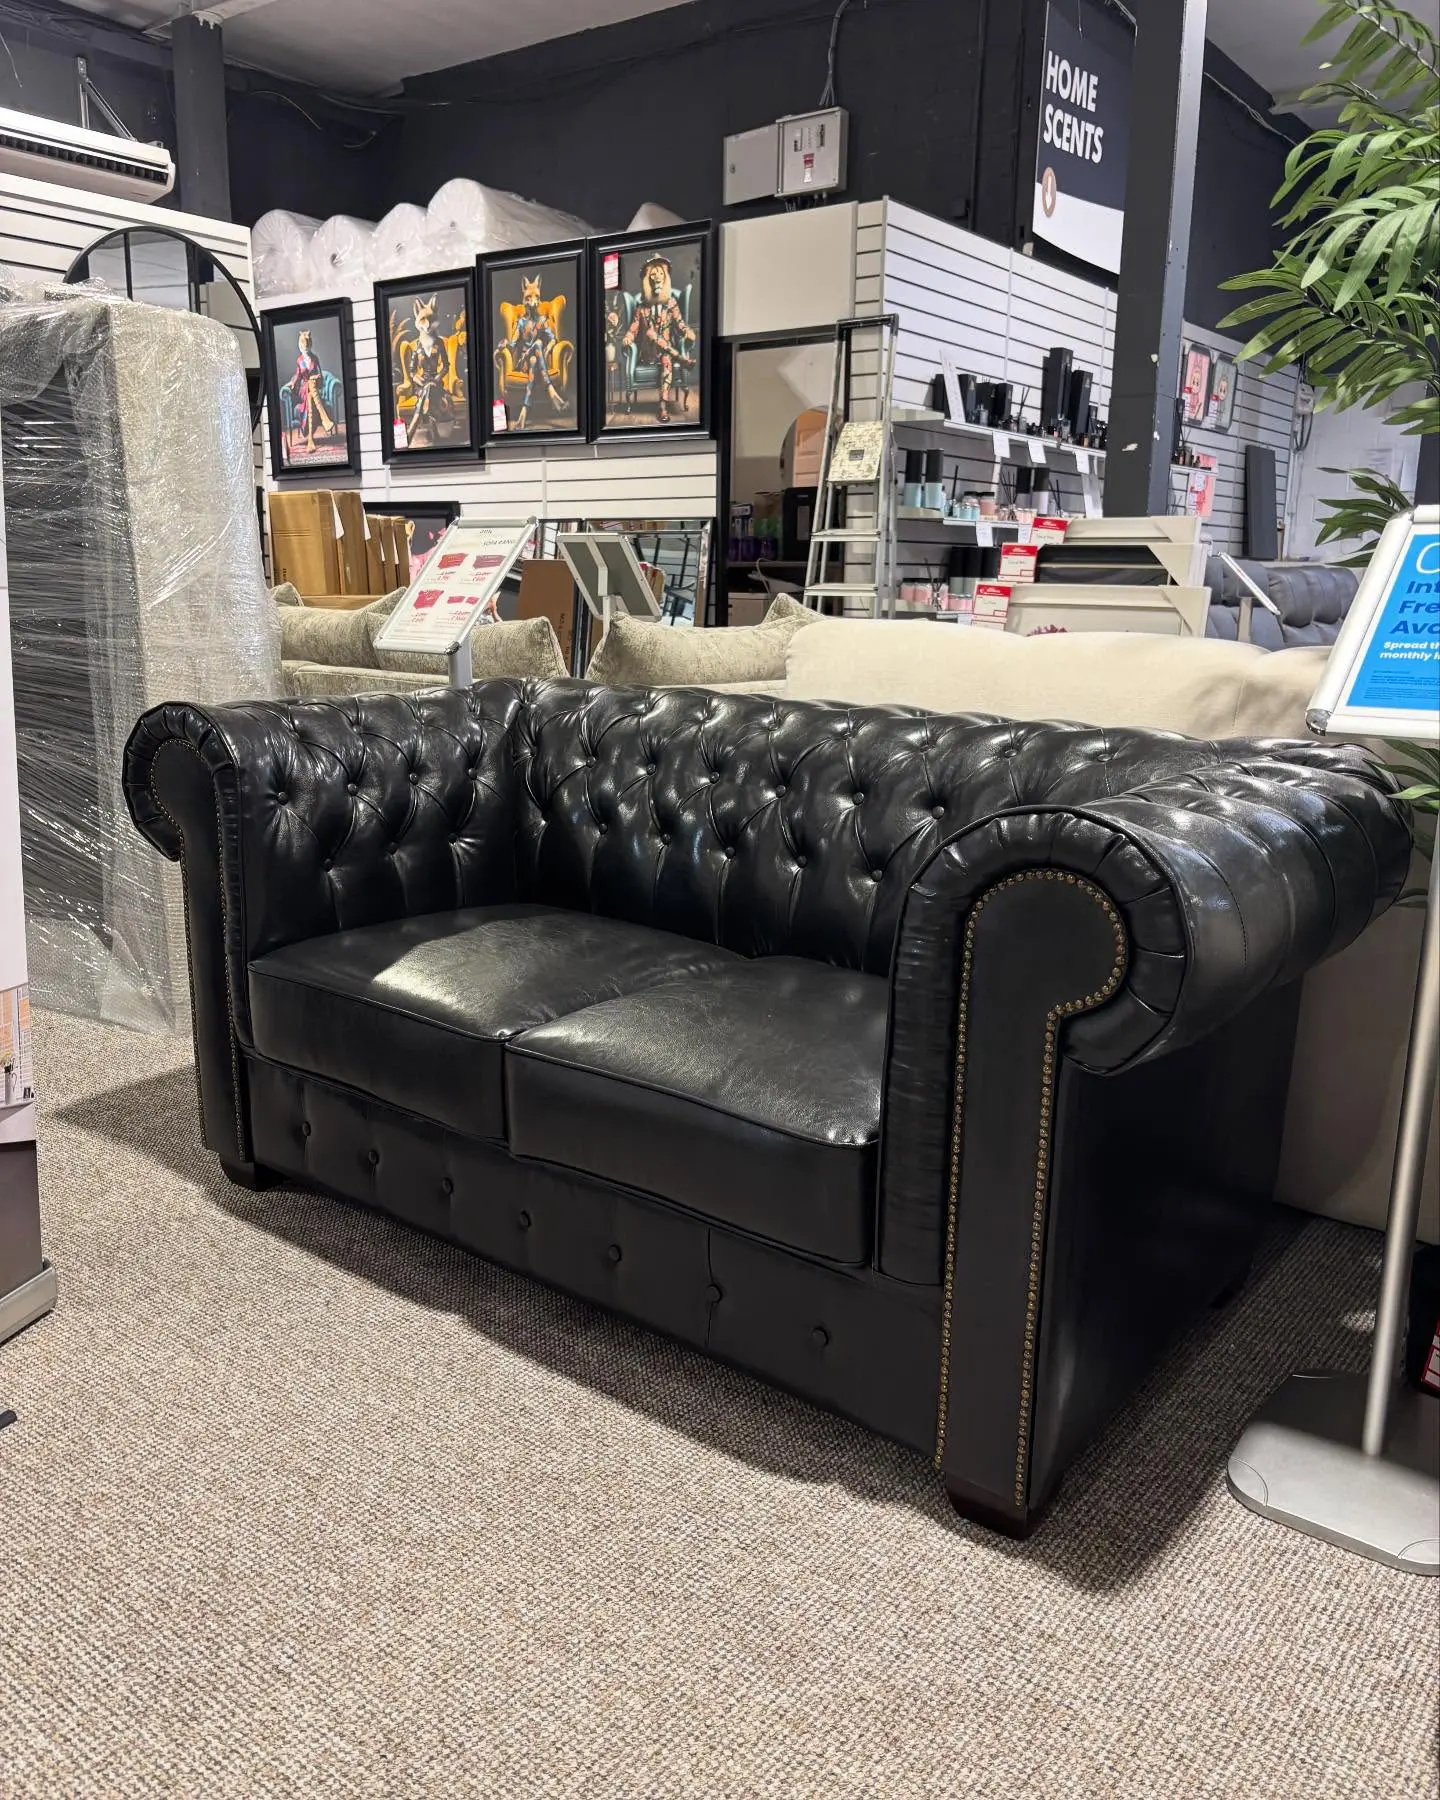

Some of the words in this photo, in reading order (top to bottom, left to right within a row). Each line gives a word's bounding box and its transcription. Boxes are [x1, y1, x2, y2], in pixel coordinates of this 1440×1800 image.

[1046, 50, 1098, 112] HOME
[1043, 104, 1104, 163] SCENTS
[1379, 651, 1432, 661] monthly
[1383, 641, 1428, 650] Spread
